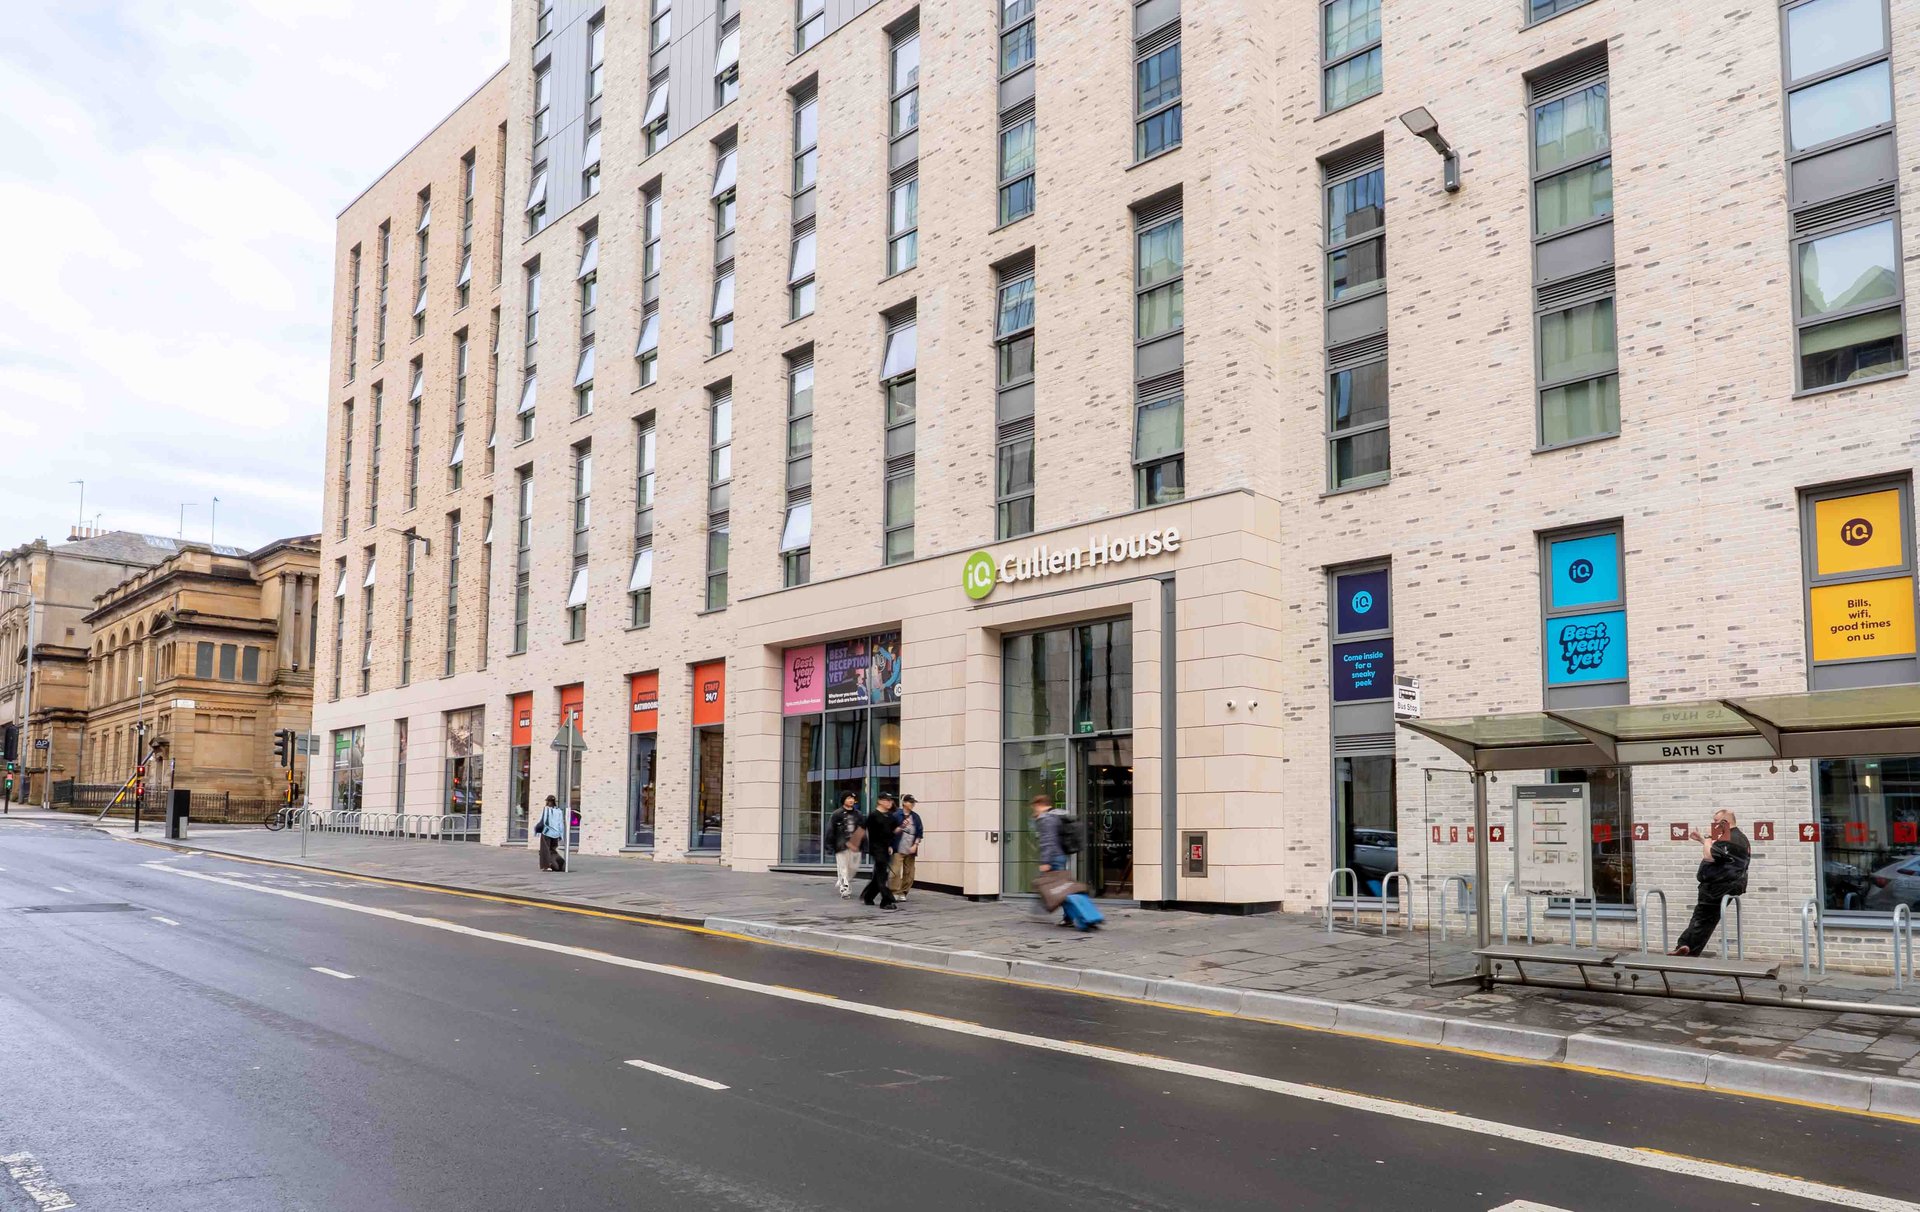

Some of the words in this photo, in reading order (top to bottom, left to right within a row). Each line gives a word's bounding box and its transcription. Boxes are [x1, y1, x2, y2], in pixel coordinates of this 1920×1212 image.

[1846, 524, 1868, 542] iQ
[967, 561, 991, 589] iQ
[1000, 545, 1081, 583] Cullen
[1089, 526, 1181, 567] House
[1572, 564, 1590, 578] iQ
[1356, 596, 1370, 609] iQ
[1562, 623, 1607, 642] Best
[1830, 622, 1858, 634] good
[1860, 620, 1891, 630] times
[1847, 633, 1860, 641] on
[829, 647, 848, 659] BEST
[1565, 637, 1610, 656] year
[794, 657, 814, 669] Best
[829, 656, 870, 670] RECEPTION
[1343, 653, 1363, 662] Come
[1364, 651, 1384, 660] inside
[1570, 650, 1603, 672] yet
[1354, 661, 1366, 670] for
[795, 667, 815, 678] year
[829, 671, 843, 683] YET
[1352, 670, 1376, 680] sneaky
[796, 676, 811, 690] yet
[1354, 679, 1372, 688] peek
[1397, 702, 1406, 710] Bus
[1407, 704, 1418, 712] Stop
[1662, 746, 1700, 757] BATH
[1707, 744, 1724, 755] ST
